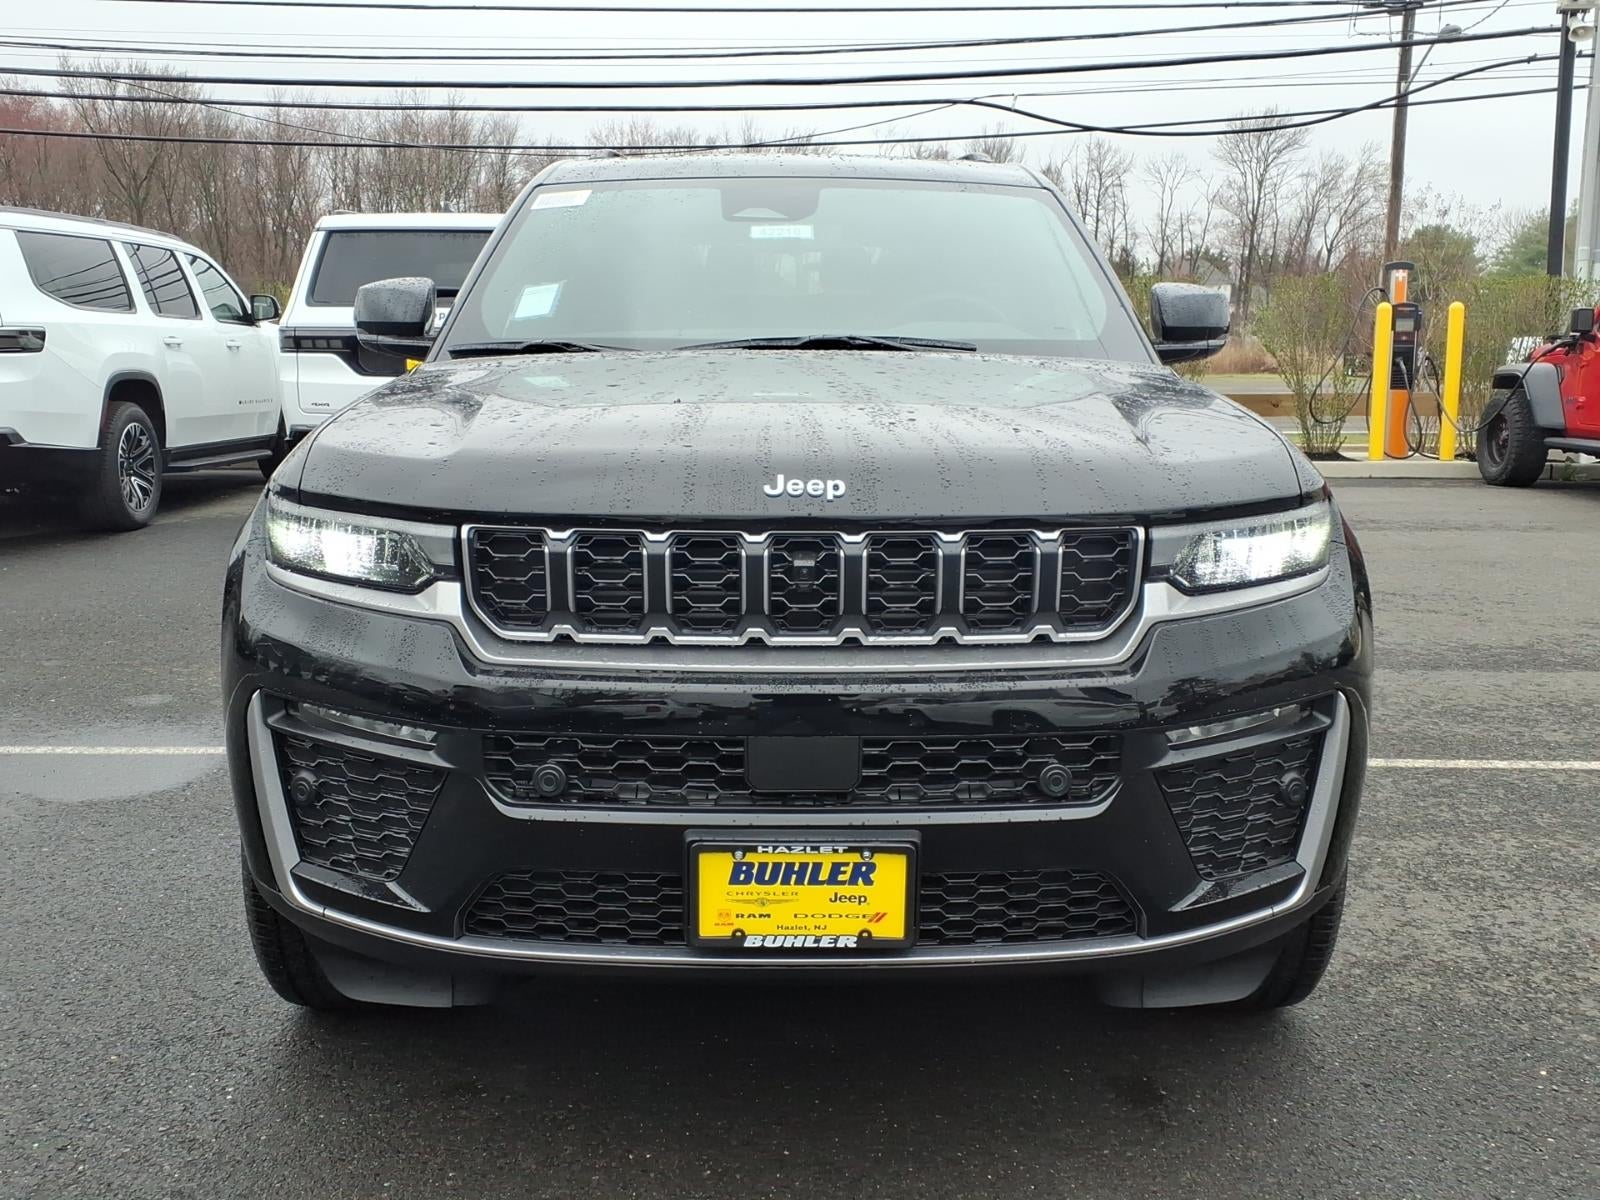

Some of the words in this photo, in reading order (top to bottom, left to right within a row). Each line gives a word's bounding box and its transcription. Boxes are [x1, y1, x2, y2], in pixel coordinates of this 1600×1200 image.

[763, 474, 846, 500] Jeep
[757, 846, 848, 854] HAZLET
[728, 861, 877, 886] BUHLER
[829, 892, 868, 906] Jeep
[744, 935, 859, 948] BUHLER
